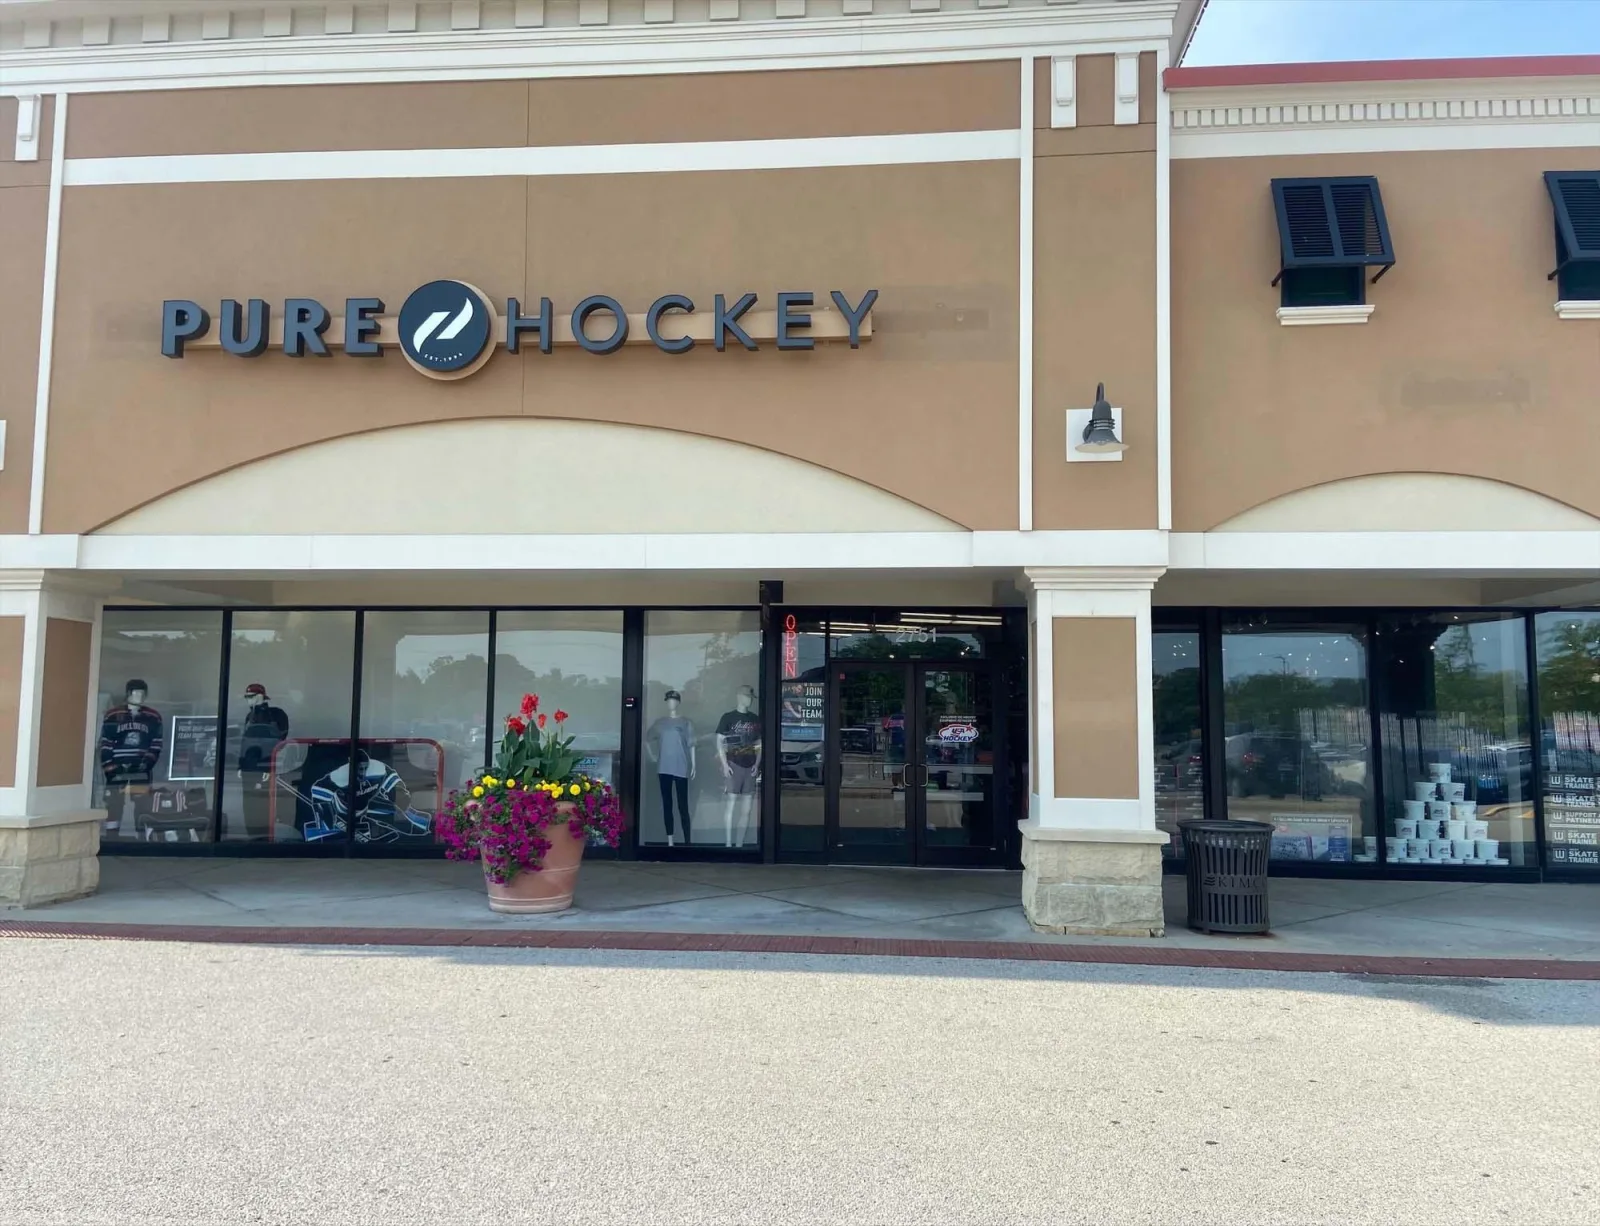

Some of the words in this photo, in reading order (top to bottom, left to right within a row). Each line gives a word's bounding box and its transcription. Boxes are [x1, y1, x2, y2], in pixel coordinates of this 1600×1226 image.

[161, 298, 386, 358] PURE
[506, 289, 878, 355] HOCKEY
[895, 627, 936, 643] 2751
[785, 614, 797, 679] OPEN
[805, 686, 822, 696] JOIN
[806, 697, 822, 707] OUR
[801, 709, 823, 719] TEAM
